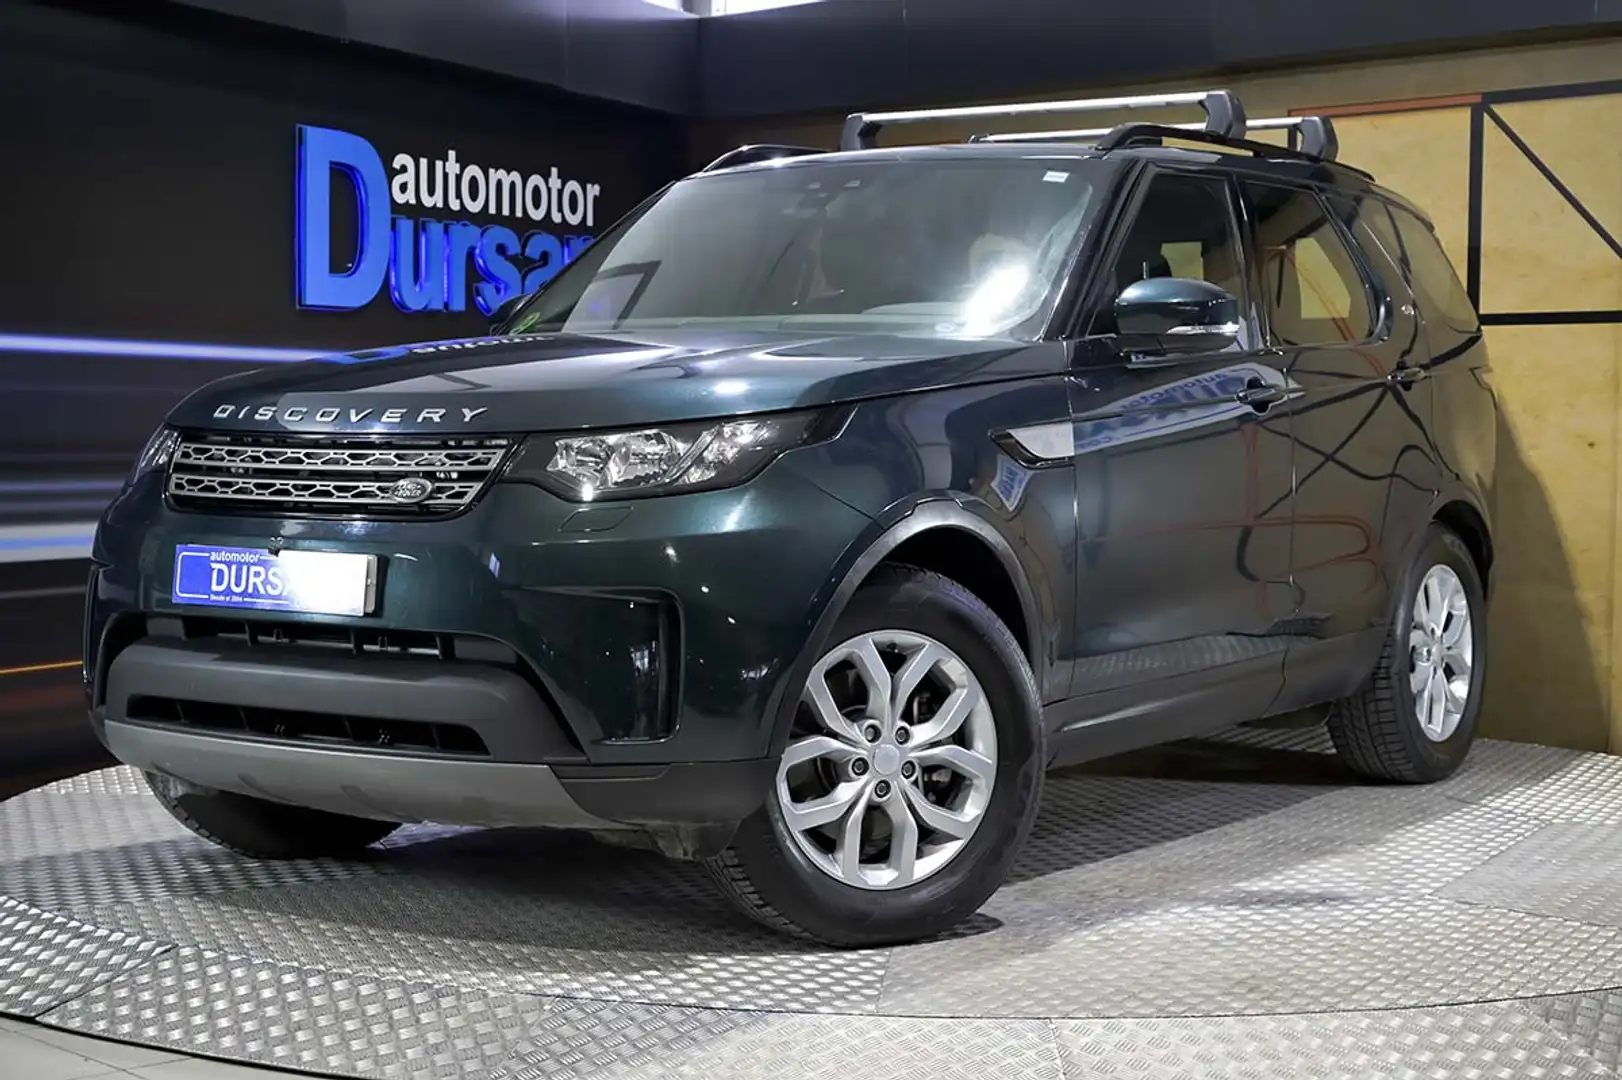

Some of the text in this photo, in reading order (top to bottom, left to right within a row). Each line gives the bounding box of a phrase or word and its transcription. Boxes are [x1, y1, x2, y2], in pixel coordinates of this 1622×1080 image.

[391, 150, 600, 227] automotor
[296, 124, 598, 316] Dursa
[213, 404, 488, 423] DISCOVERY
[210, 550, 260, 563] automotor
[210, 562, 288, 597] DURS
